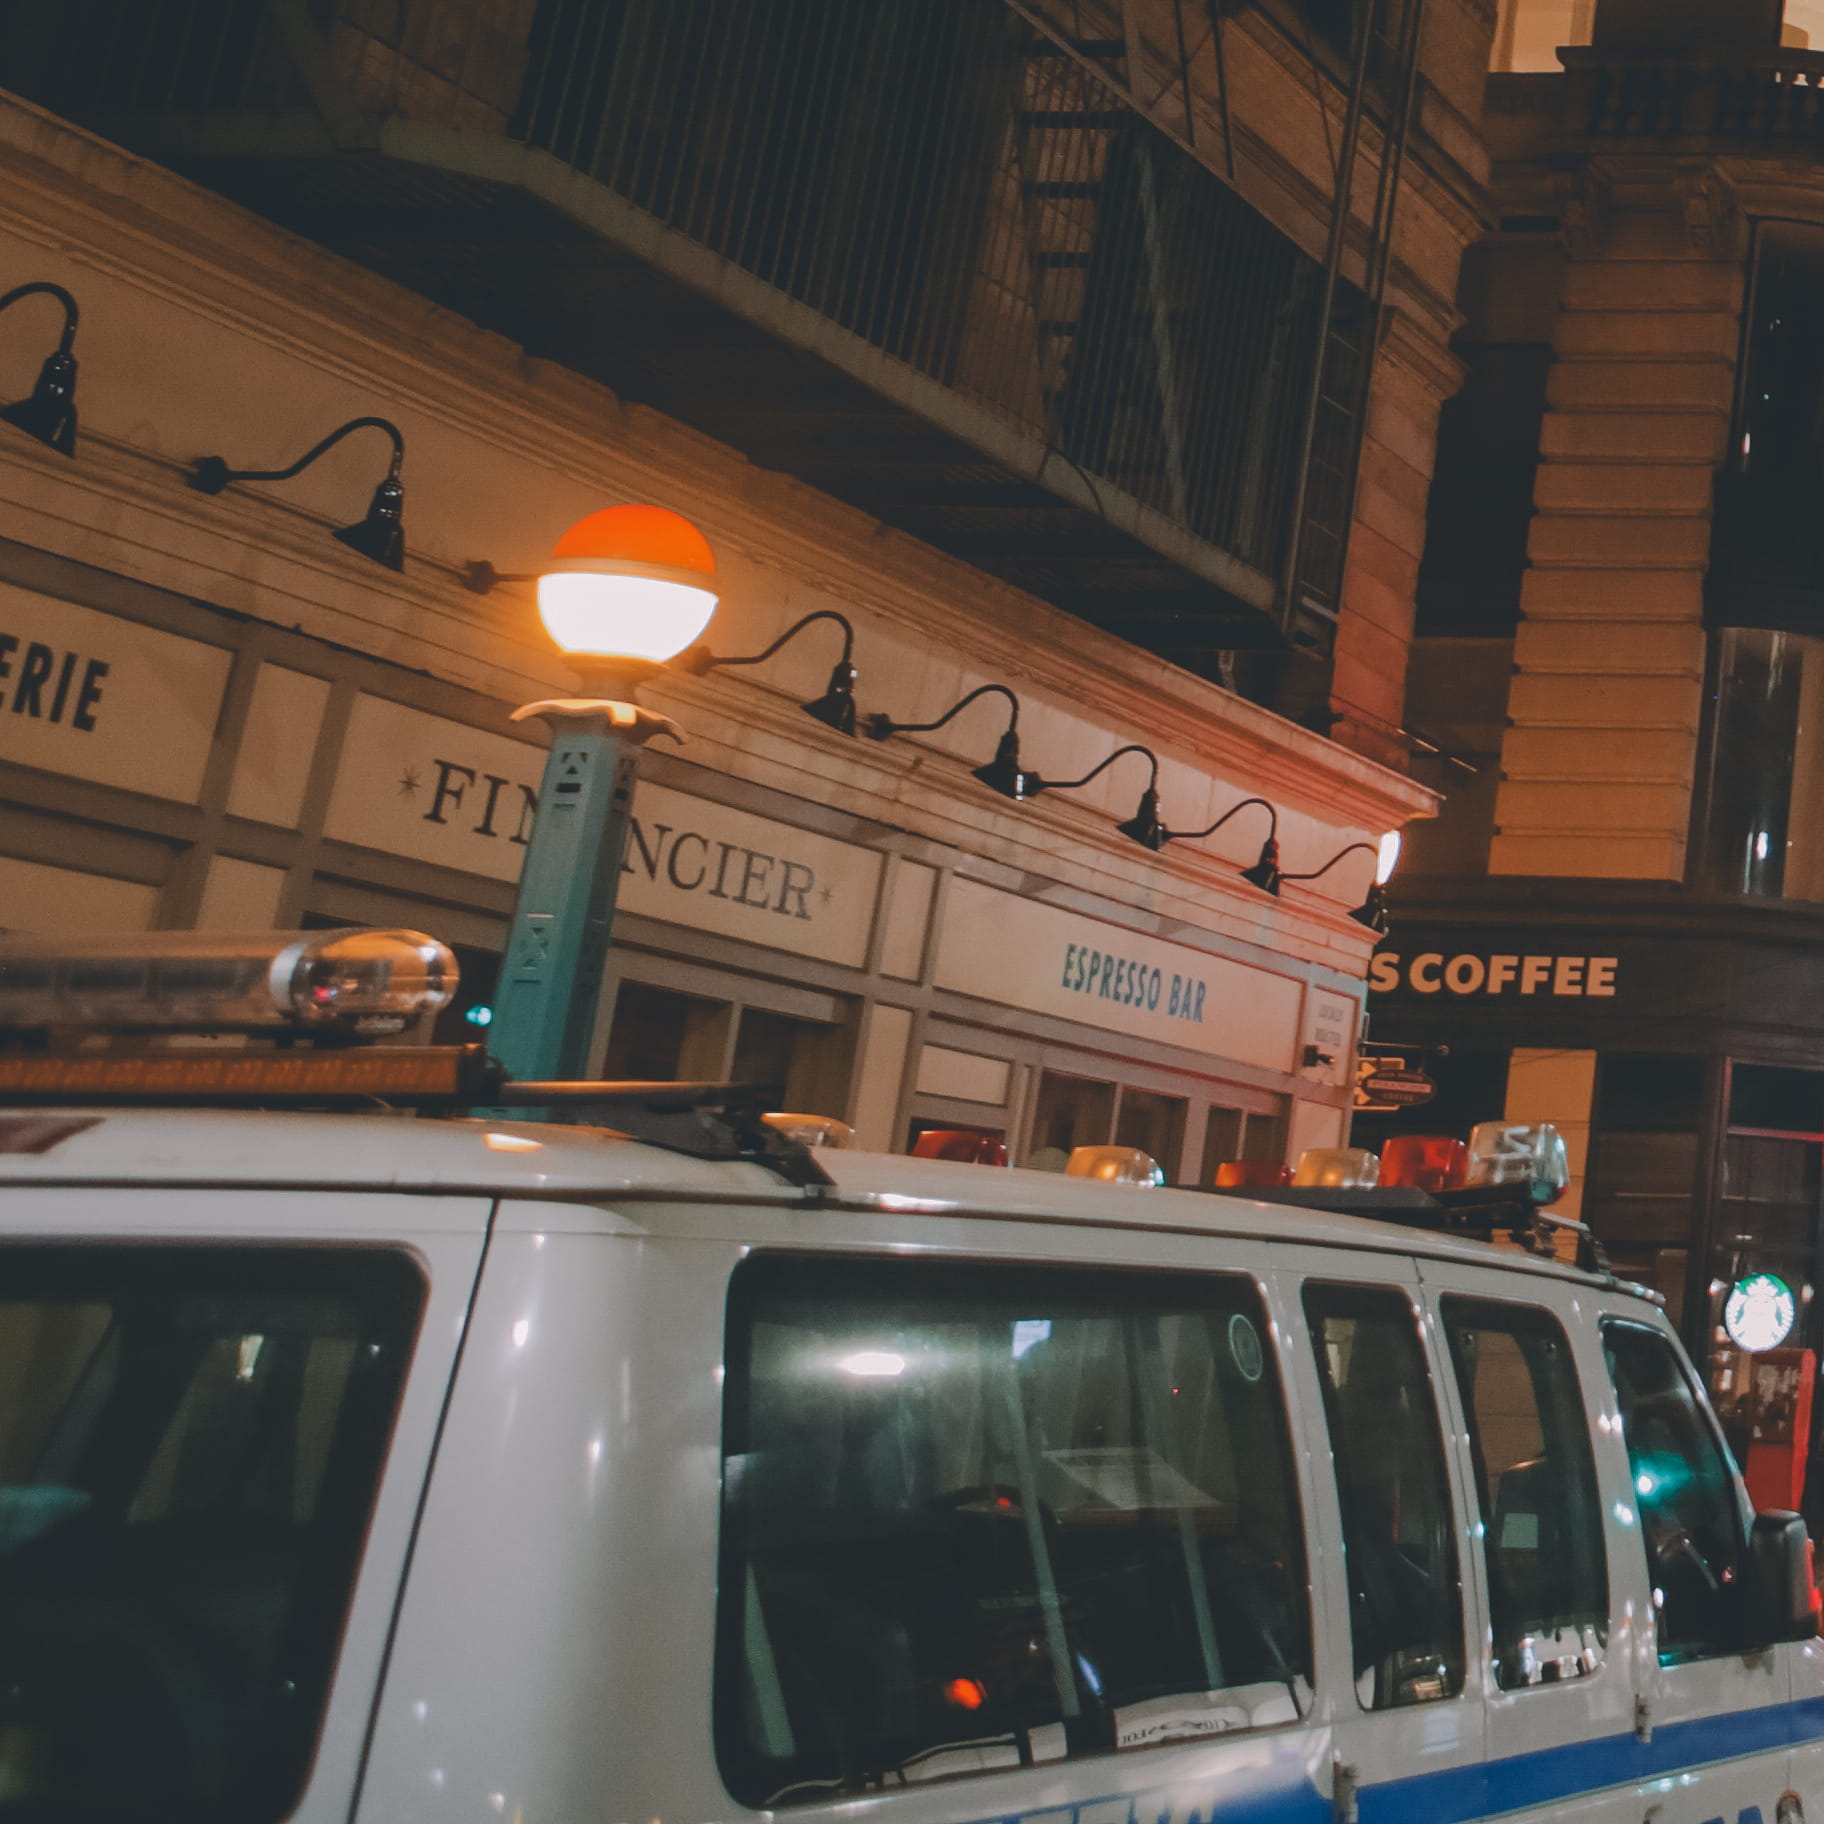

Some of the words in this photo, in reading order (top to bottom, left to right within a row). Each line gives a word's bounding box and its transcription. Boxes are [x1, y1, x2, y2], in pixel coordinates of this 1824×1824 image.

[1061, 943, 1161, 1011] ESPRESSO
[1168, 973, 1206, 1023] BAR
[1409, 952, 1618, 996] COFFEE
